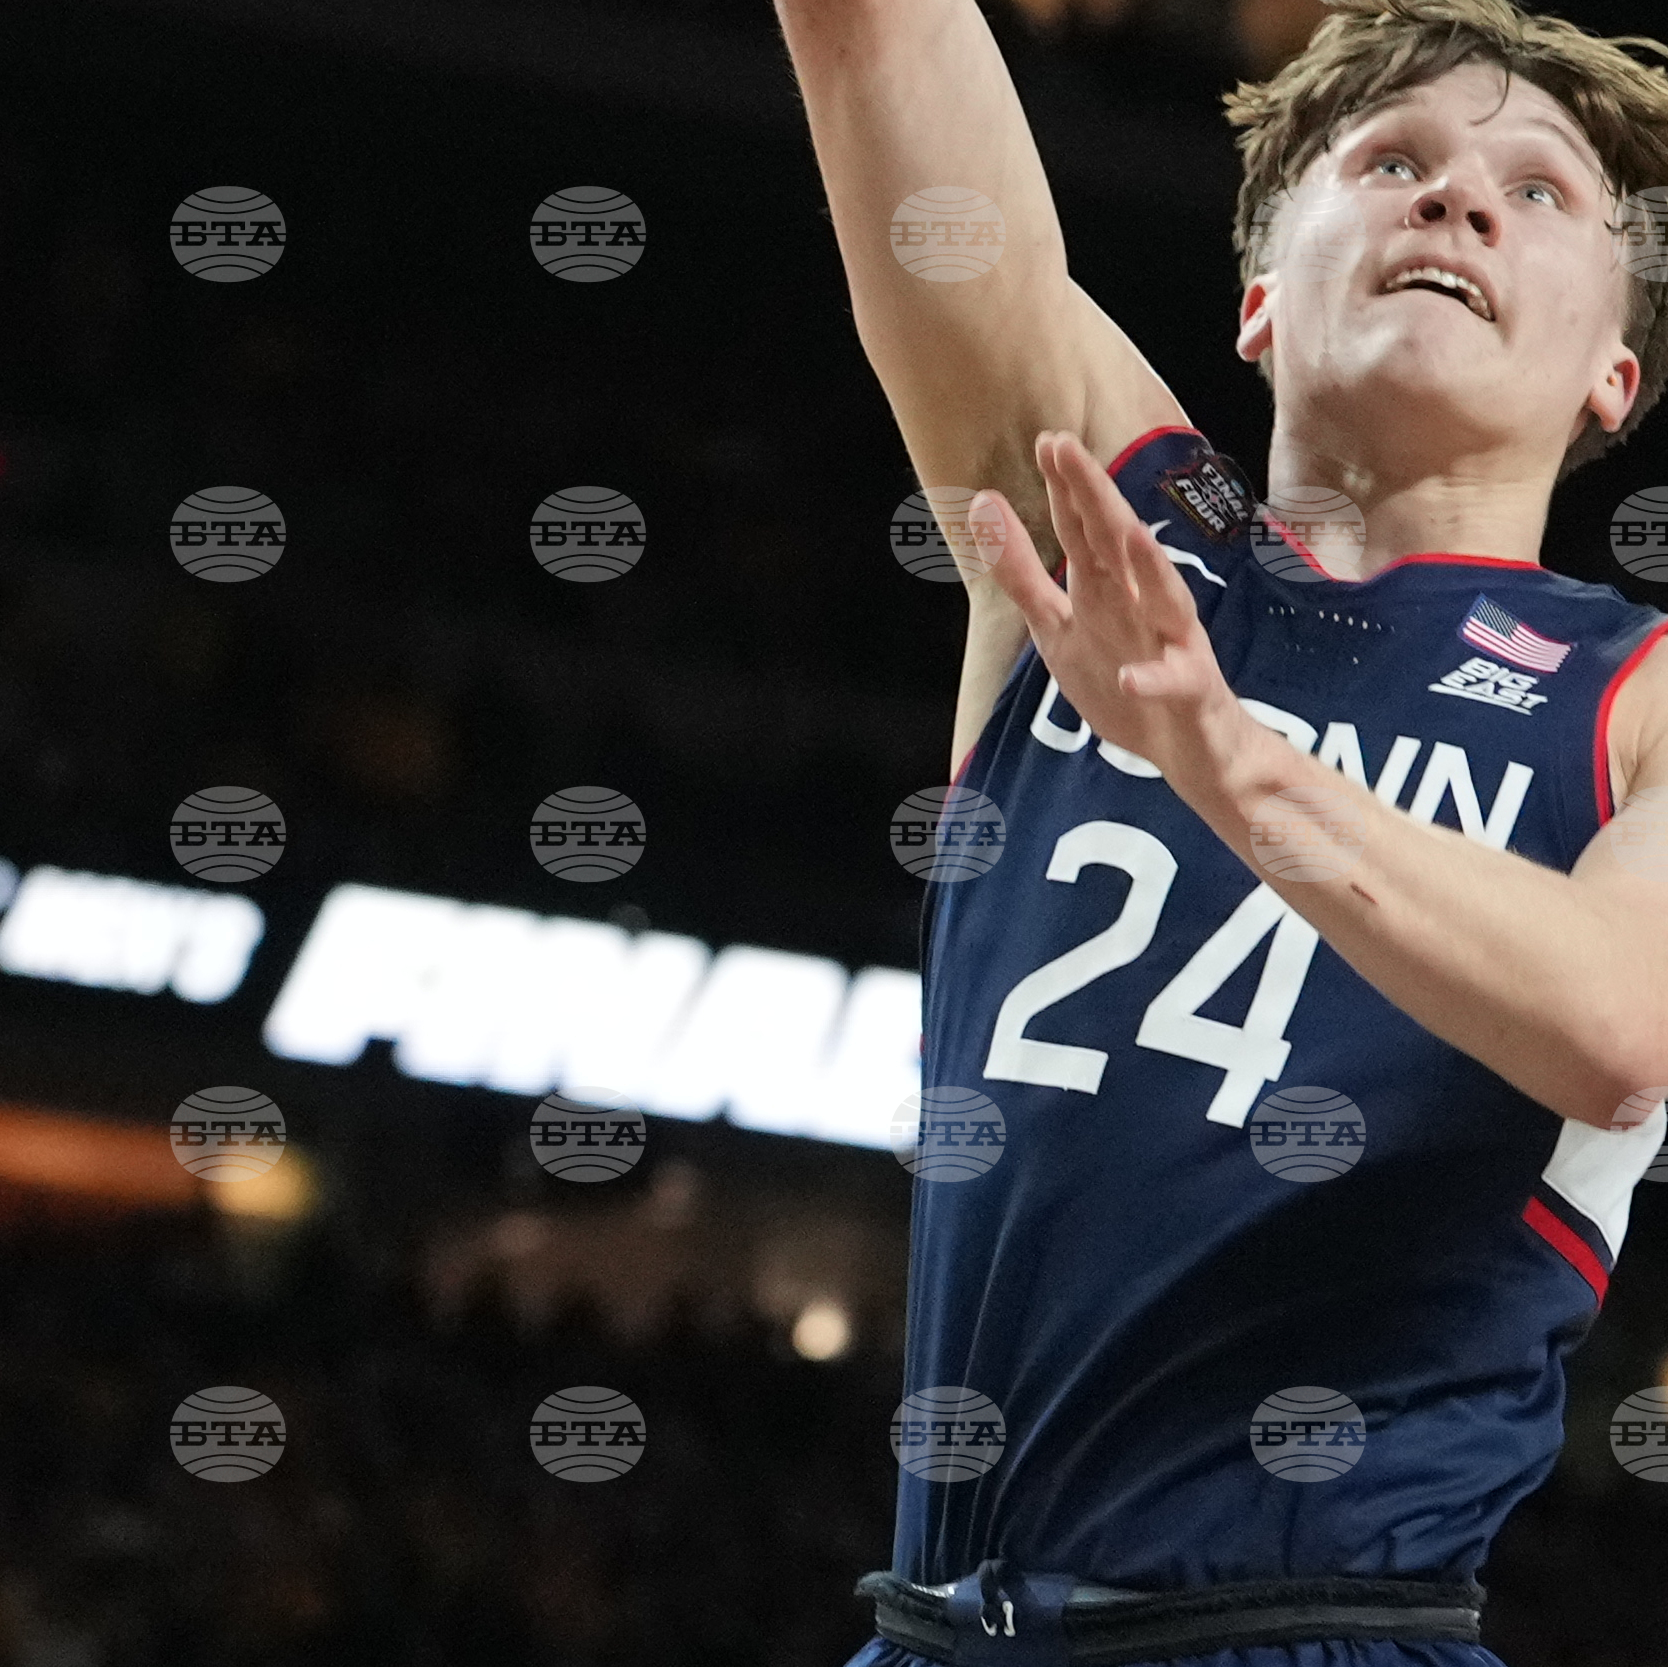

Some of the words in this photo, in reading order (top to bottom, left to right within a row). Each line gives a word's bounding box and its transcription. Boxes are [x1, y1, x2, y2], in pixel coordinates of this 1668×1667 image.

[1176, 478, 1226, 532] FOUR
[1201, 461, 1249, 522] FINAL
[1440, 669, 1549, 710] EAST
[1459, 656, 1540, 692] BIG
[983, 819, 1320, 1129] 24
